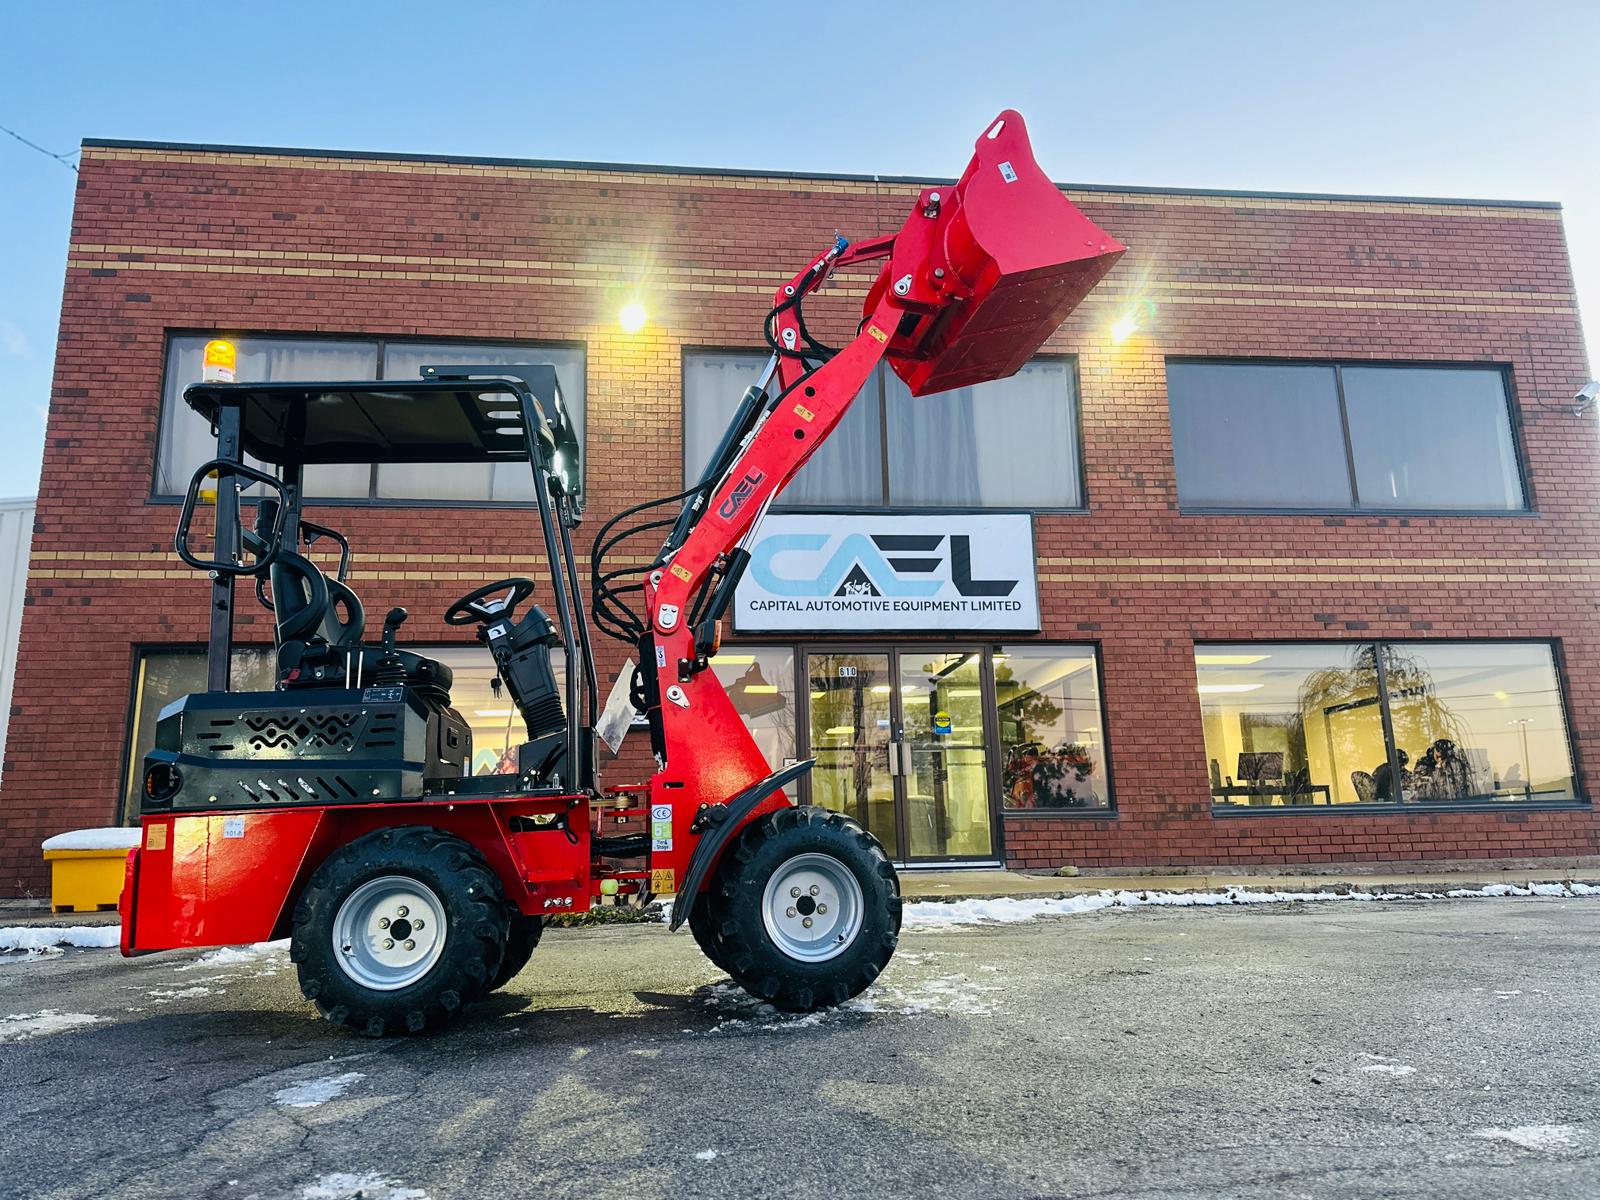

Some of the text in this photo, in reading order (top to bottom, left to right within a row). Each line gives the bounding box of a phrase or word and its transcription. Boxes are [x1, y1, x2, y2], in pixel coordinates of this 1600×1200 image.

[719, 472, 763, 518] CAEL
[750, 533, 1019, 597] CAEL
[750, 600, 1021, 611] CAPITAL AUTOMOTIVE EQUIPMENT LIMITED
[839, 667, 856, 676] 610
